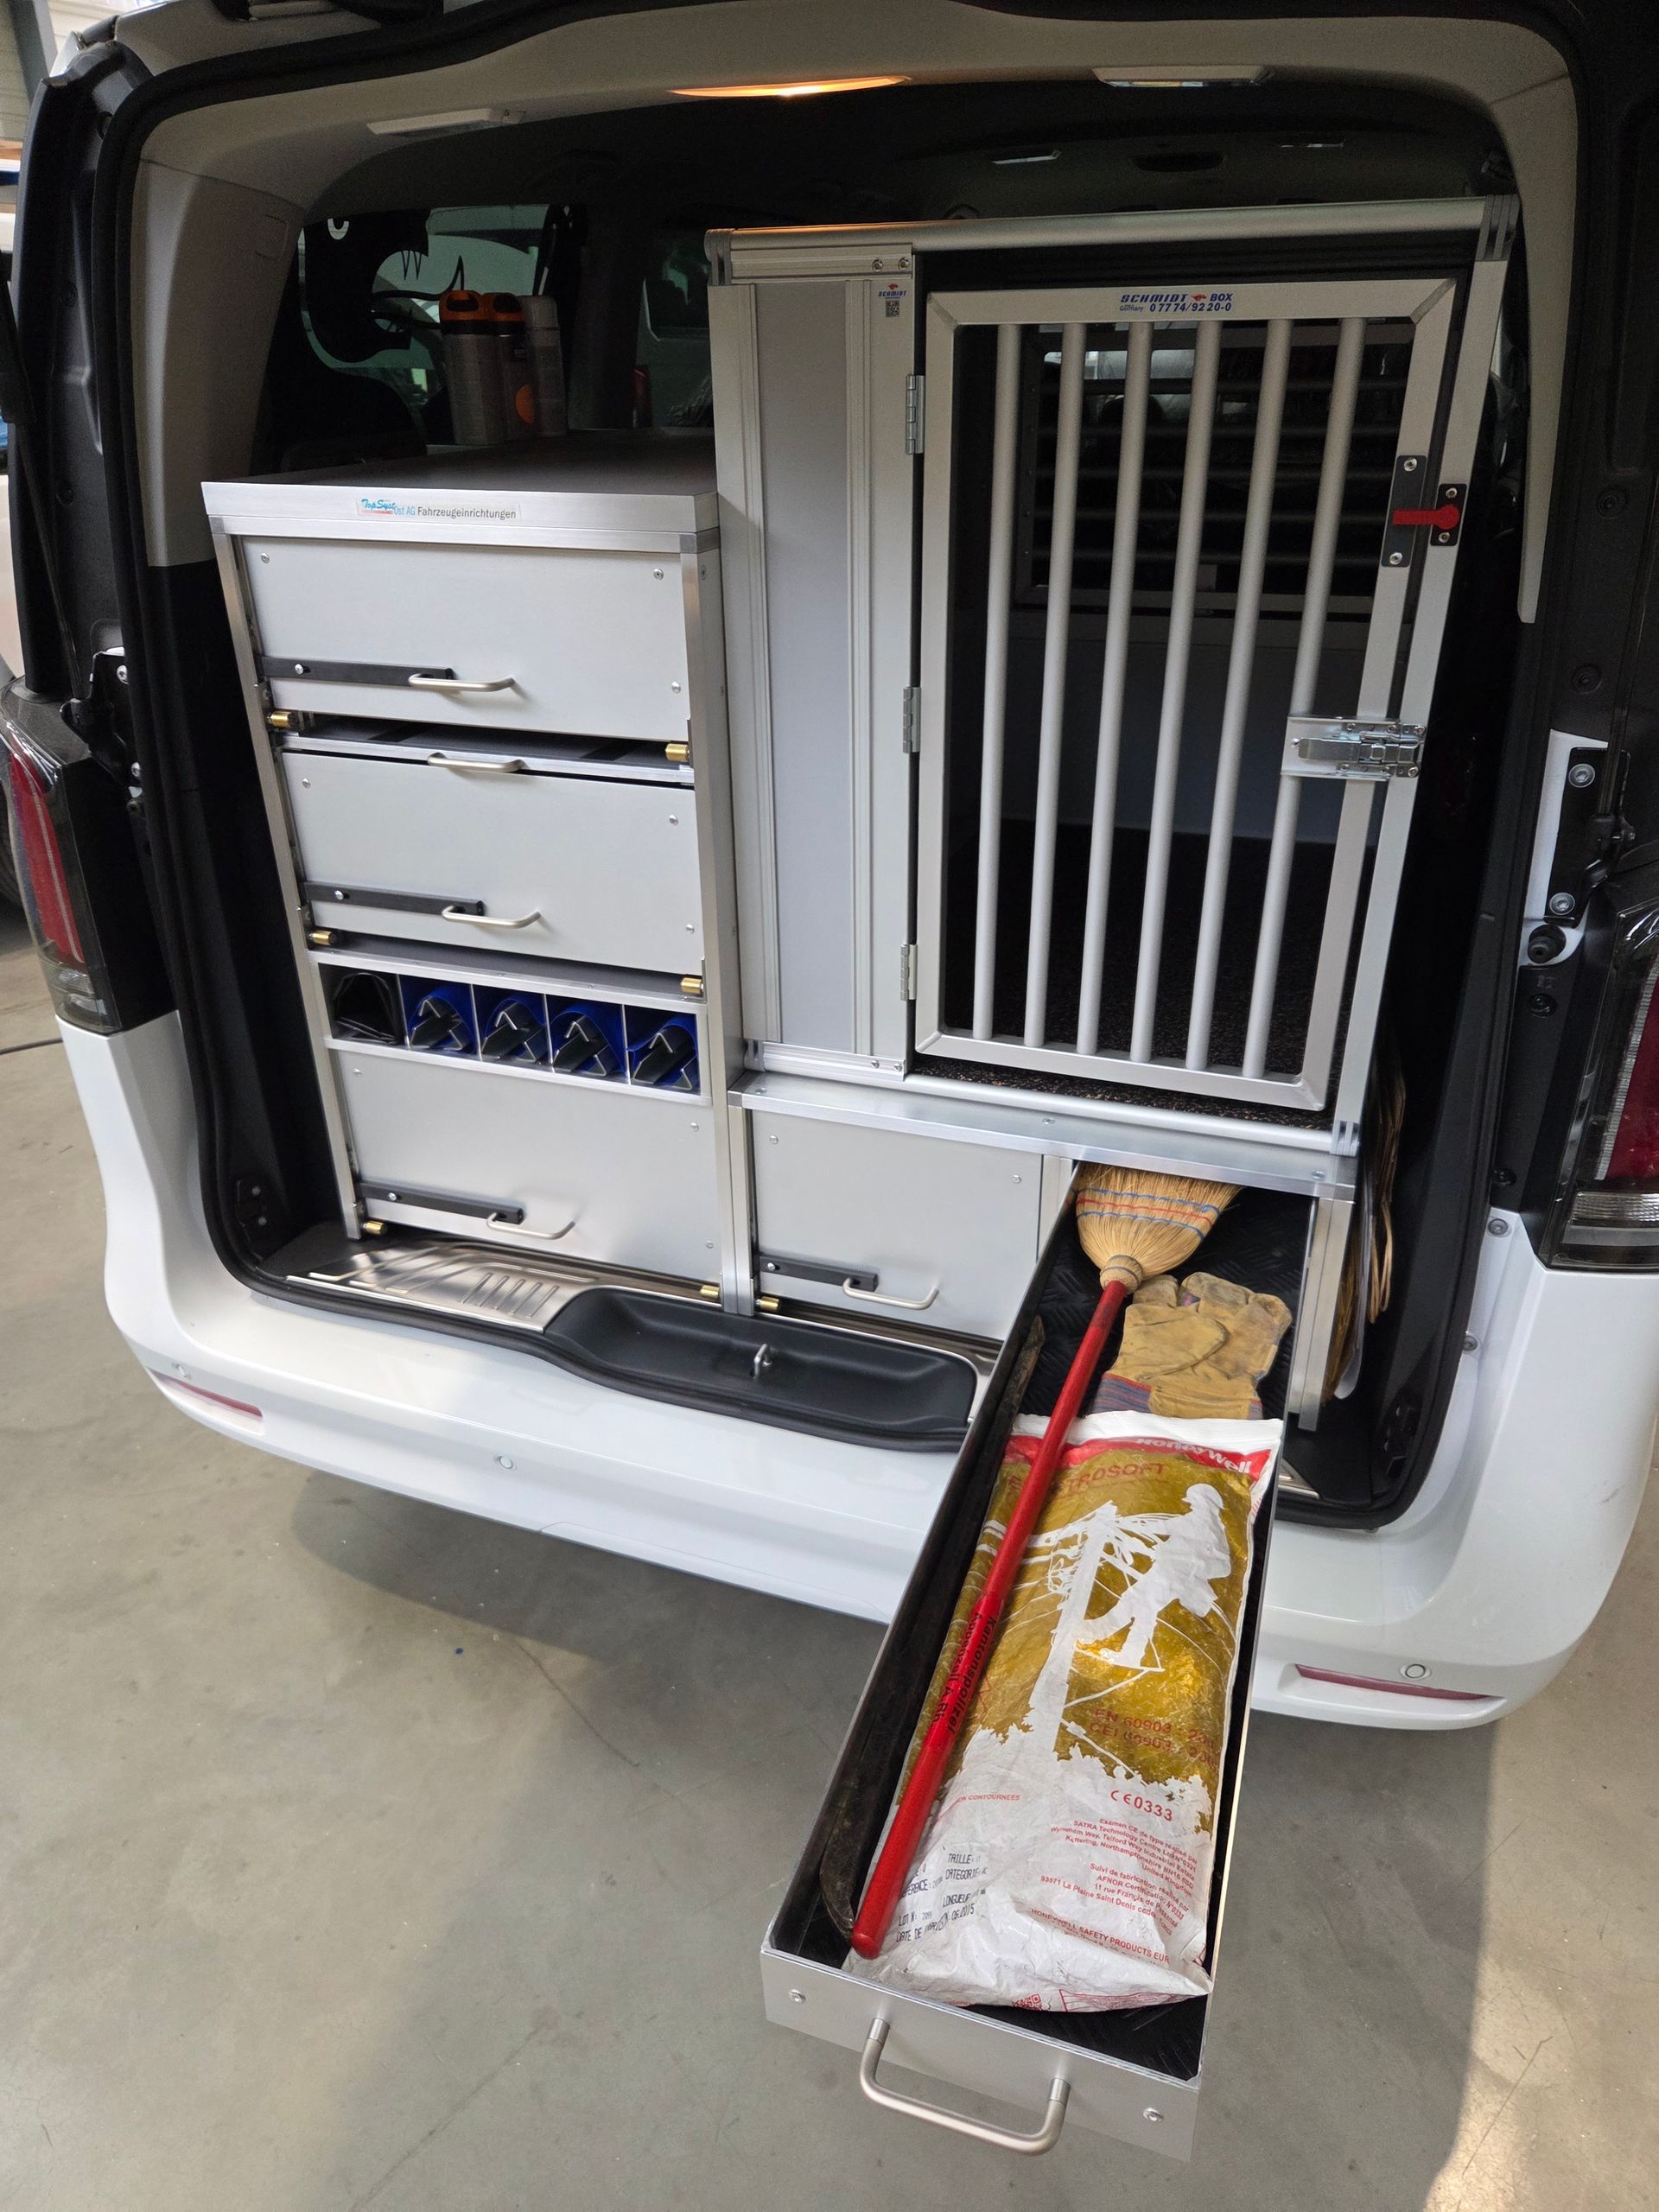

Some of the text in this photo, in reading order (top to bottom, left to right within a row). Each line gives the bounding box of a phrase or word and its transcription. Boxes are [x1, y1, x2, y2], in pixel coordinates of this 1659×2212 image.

[1121, 293, 1233, 302] SCHMIDT BOX
[406, 507, 416, 516] AG
[417, 506, 517, 520] Fahrzeugeinrichtungen
[1136, 1438, 1252, 1473] Honeywell
[947, 1616, 997, 1734] Kantonspolizei
[1095, 1708, 1118, 1722] EN
[1089, 1722, 1118, 1738] CEI
[1073, 1820, 1097, 1830] SATRA
[1099, 1826, 1138, 1843] Technology
[1139, 1838, 1161, 1853] Centre
[1098, 1818, 1127, 1828] Examen
[1140, 1829, 1148, 1838] de
[1149, 1834, 1164, 1847] type
[1103, 1834, 1127, 1846] Telford
[1128, 1840, 1143, 1853] Way
[1100, 1841, 1162, 1869] Northamptonshire
[1090, 1863, 1108, 1873] Suivi
[1109, 1868, 1119, 1877] de
[1120, 1872, 1157, 1891] fabrication
[1096, 1875, 1123, 1887] AFNOR
[1141, 1863, 1192, 1897] United Kingdom
[1040, 1875, 1062, 1886] 93571
[1063, 1881, 1071, 1890] La
[1072, 1885, 1095, 1898] Plaine
[1096, 1892, 1115, 1904] Saint
[1116, 1898, 1136, 1910] Denis
[1094, 1883, 1103, 1891] 11
[1146, 1897, 1155, 1906] de
[914, 1927, 923, 1940] DE
[1031, 1908, 1078, 1930] HONEYWELL
[1078, 1925, 1109, 1942] SAFETY
[1109, 1936, 1153, 1957] PRODUCTS
